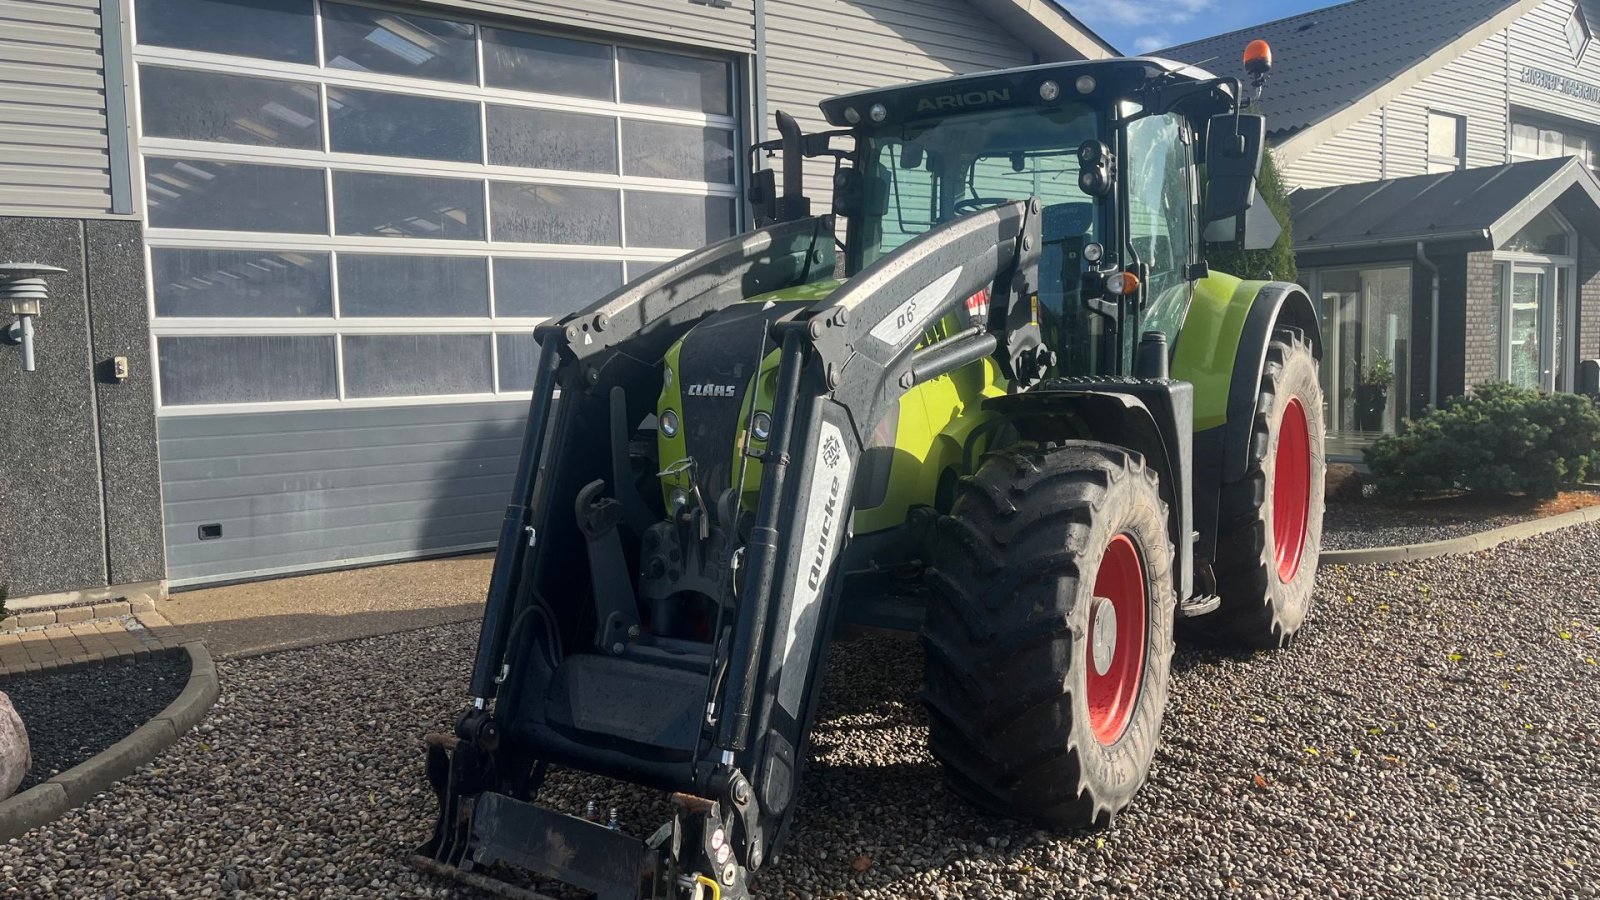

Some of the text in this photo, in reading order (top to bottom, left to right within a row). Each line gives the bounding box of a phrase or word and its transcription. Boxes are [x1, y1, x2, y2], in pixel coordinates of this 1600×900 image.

[917, 87, 1011, 112] ARION
[688, 383, 736, 397] CLAAS
[808, 475, 840, 592] Quicke
